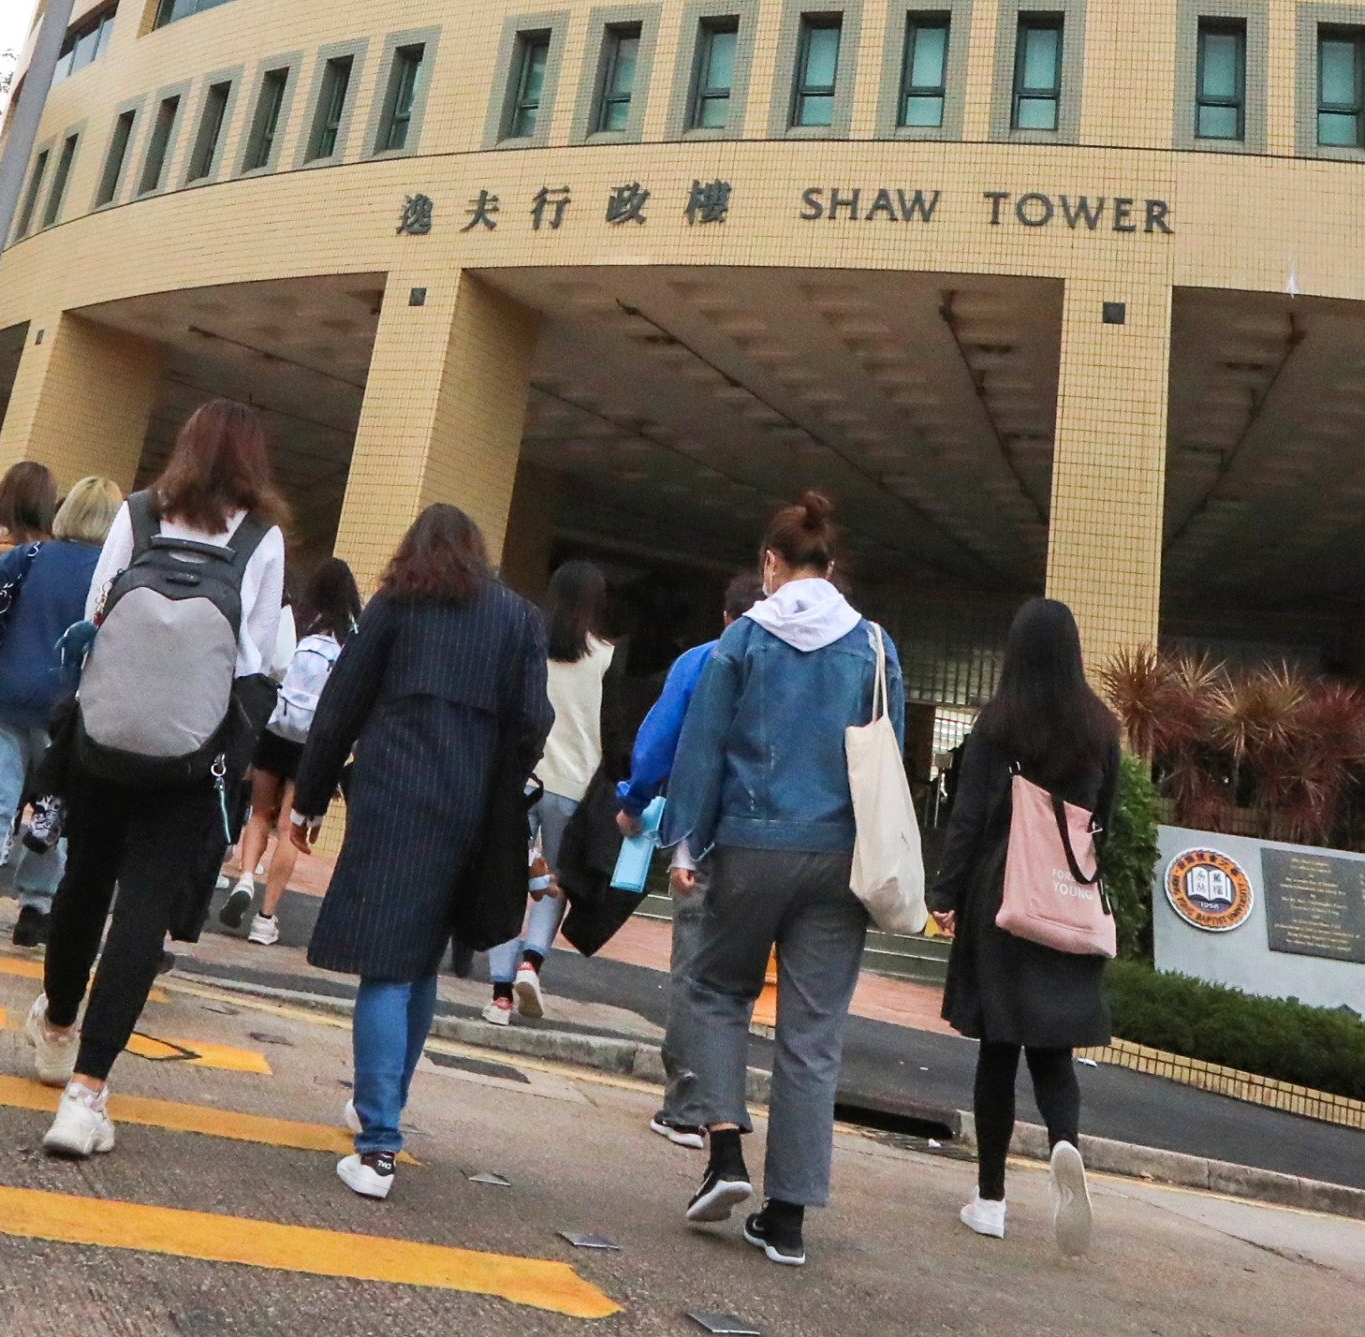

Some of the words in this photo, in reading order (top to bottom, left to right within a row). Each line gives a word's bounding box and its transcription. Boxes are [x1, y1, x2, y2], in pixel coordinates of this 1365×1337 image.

[396, 178, 732, 235] 逸夫行政樓
[800, 187, 940, 222] SHAW
[983, 191, 1175, 234] TOWER
[1053, 880, 1094, 900] YOUNG
